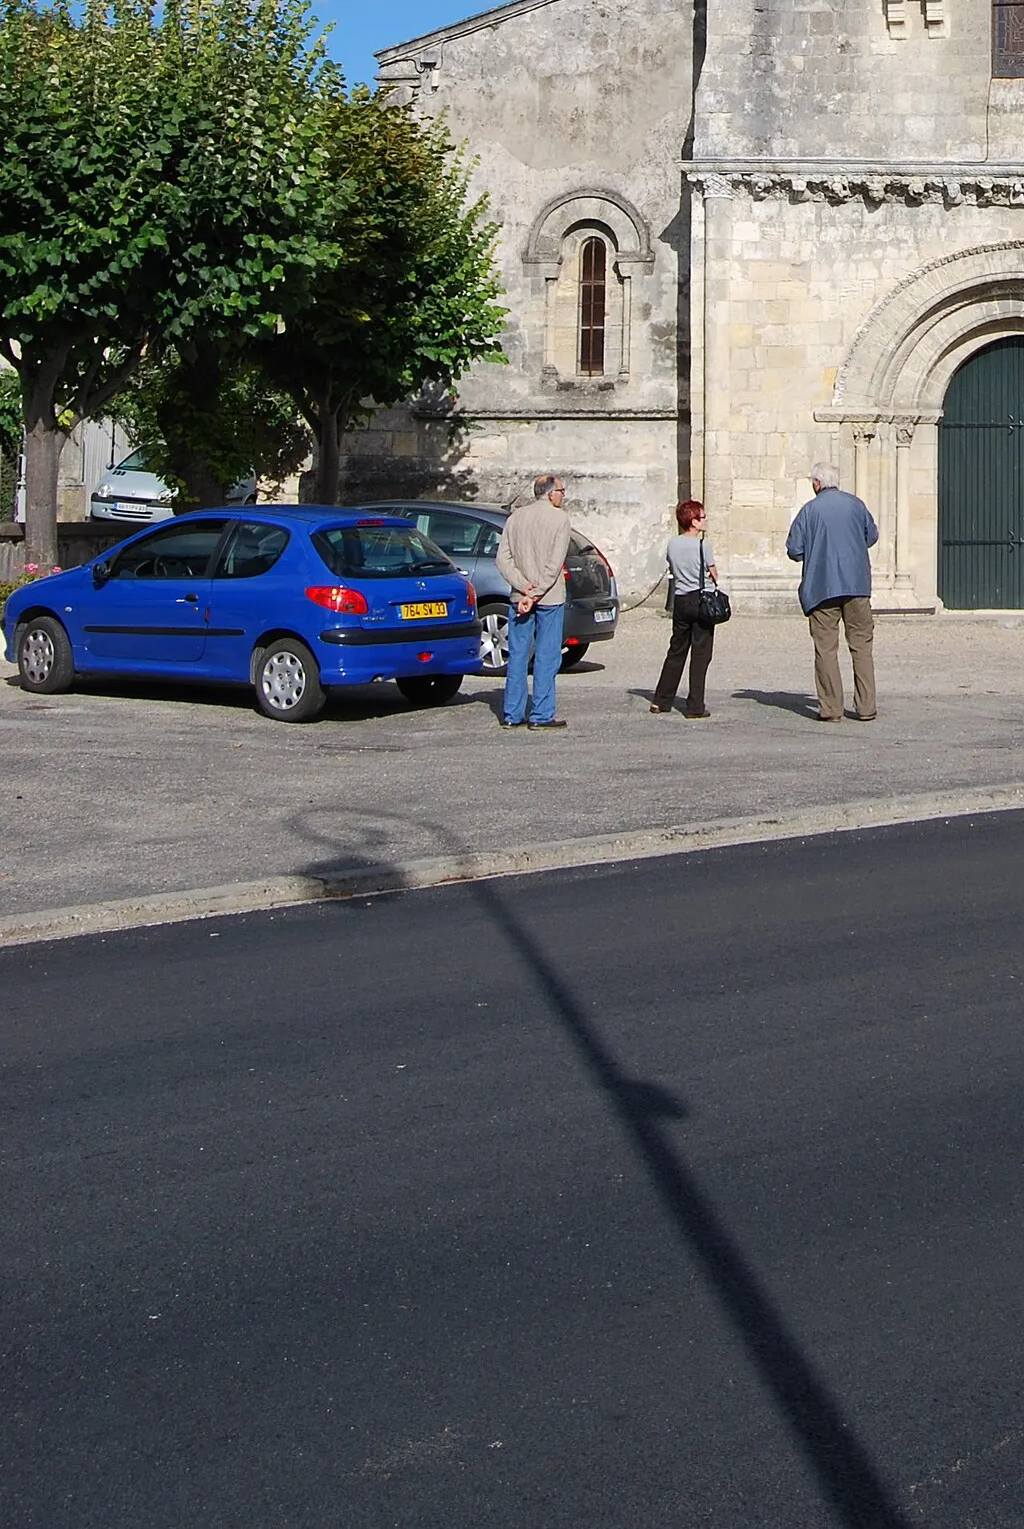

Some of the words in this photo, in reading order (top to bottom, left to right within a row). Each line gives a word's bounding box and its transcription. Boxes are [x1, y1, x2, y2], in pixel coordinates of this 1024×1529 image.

[404, 605, 420, 617] 764
[423, 604, 433, 615] SW
[436, 603, 446, 615] 33
